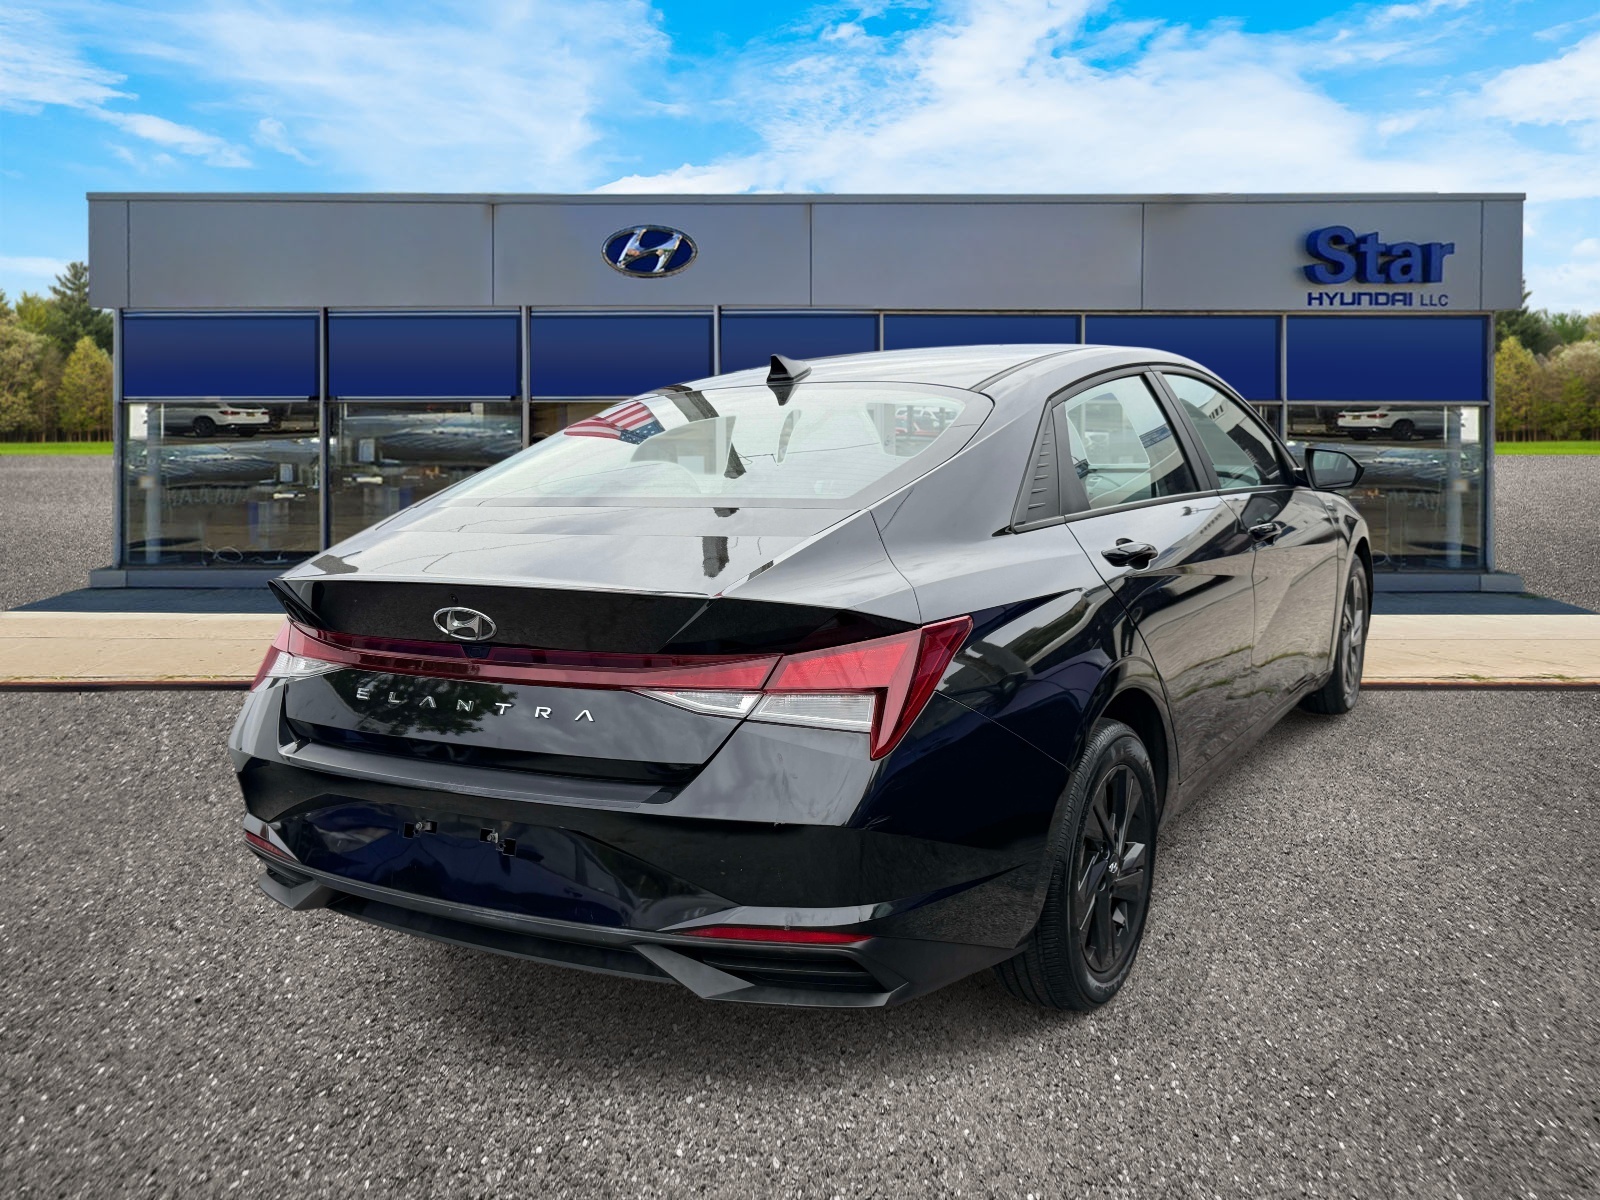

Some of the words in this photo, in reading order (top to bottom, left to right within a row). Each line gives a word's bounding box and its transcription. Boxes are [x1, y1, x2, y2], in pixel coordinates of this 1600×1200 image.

[1303, 225, 1455, 284] Star
[1307, 292, 1413, 306] HYUNDAI
[1420, 294, 1449, 306] LLC
[356, 687, 595, 722] ELANTRA
